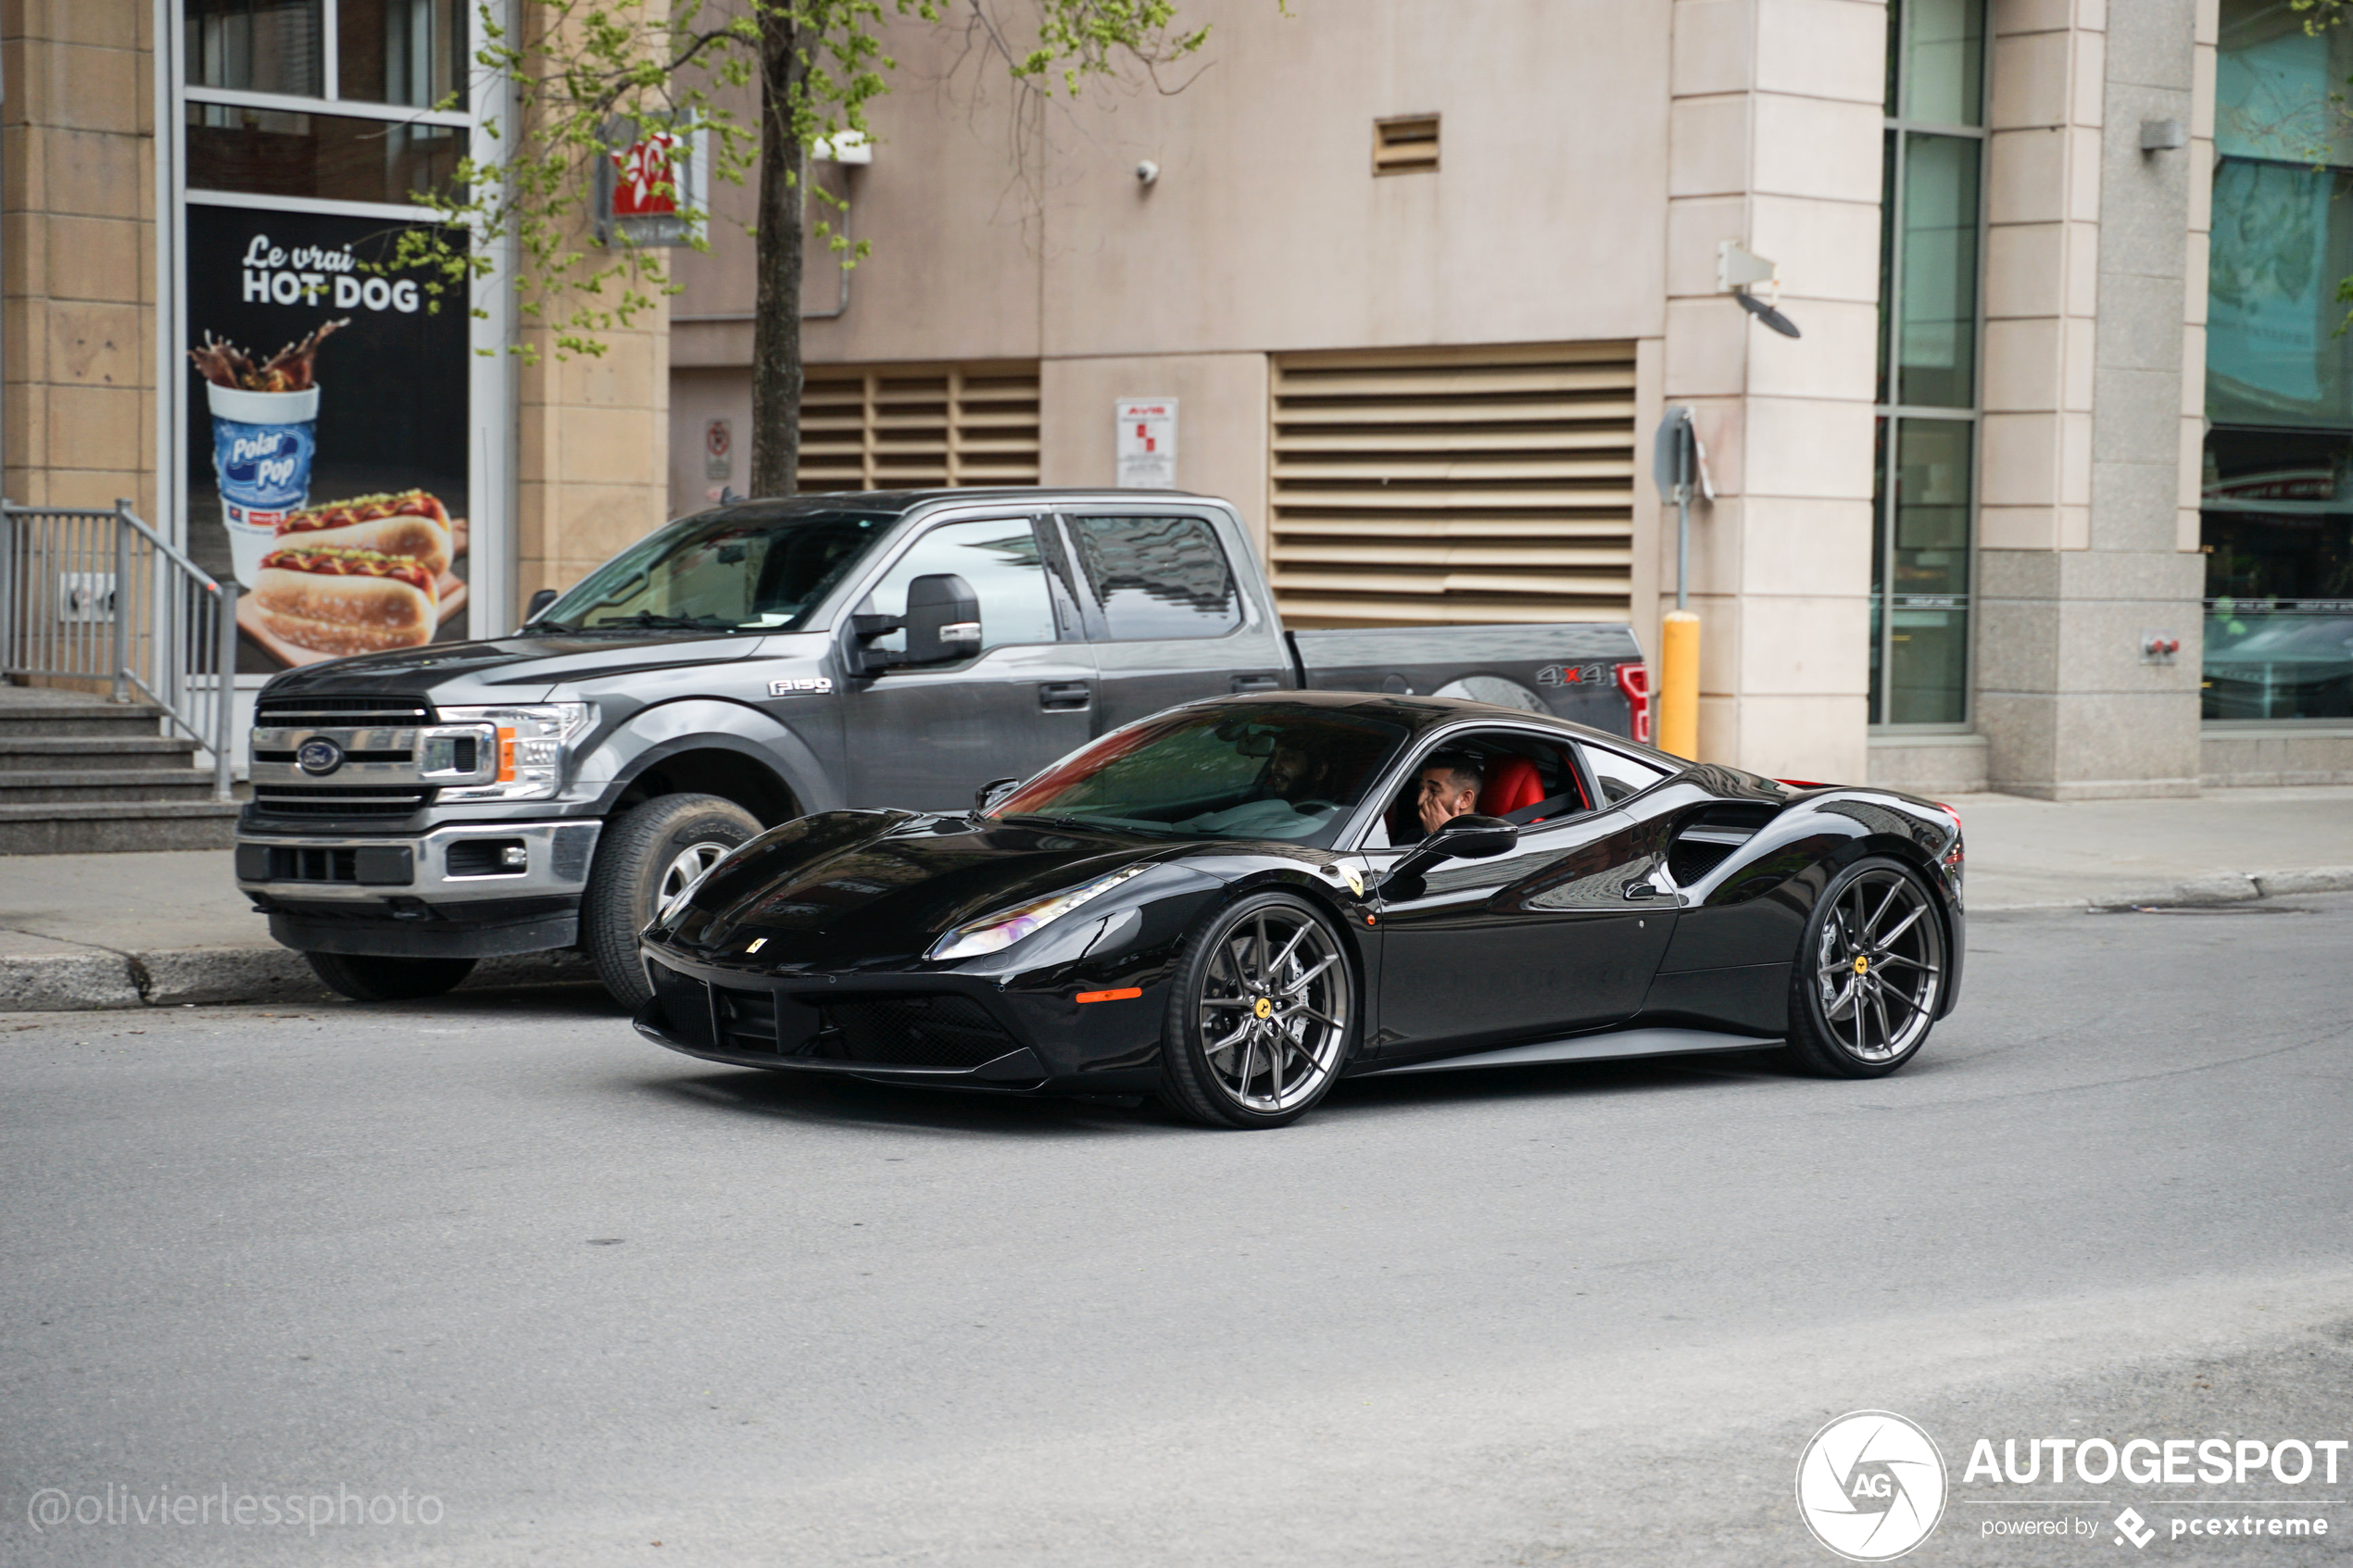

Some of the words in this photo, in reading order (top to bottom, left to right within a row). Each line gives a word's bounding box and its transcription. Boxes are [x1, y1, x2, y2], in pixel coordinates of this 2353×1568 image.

[243, 233, 288, 269] Le
[291, 243, 356, 272] vrai
[243, 269, 324, 307] HOT
[334, 274, 419, 313] DOG
[233, 431, 283, 463] Polar
[258, 458, 296, 487] Pop
[304, 747, 328, 763] Ford
